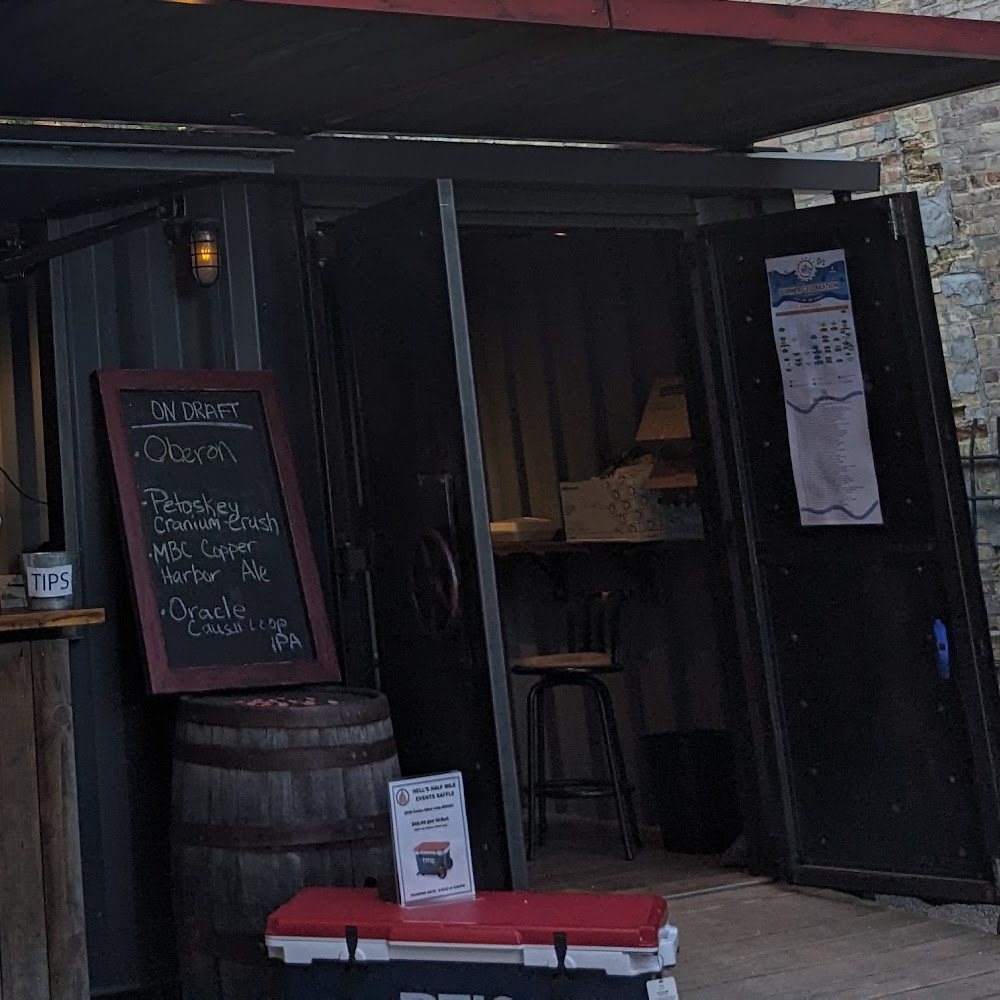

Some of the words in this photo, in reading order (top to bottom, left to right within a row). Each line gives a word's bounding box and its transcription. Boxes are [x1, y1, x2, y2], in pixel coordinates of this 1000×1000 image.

[151, 401, 176, 421] ON
[182, 401, 239, 420] DRAFT
[144, 435, 237, 463] Oberon
[154, 515, 220, 534] Cranium
[153, 541, 192, 564] MBC
[201, 540, 258, 562] Copper
[31, 571, 70, 591] TIPS
[161, 566, 221, 585] Harbor
[242, 561, 270, 582] Ale
[169, 596, 245, 621] Oracle
[272, 633, 301, 654] IPA
